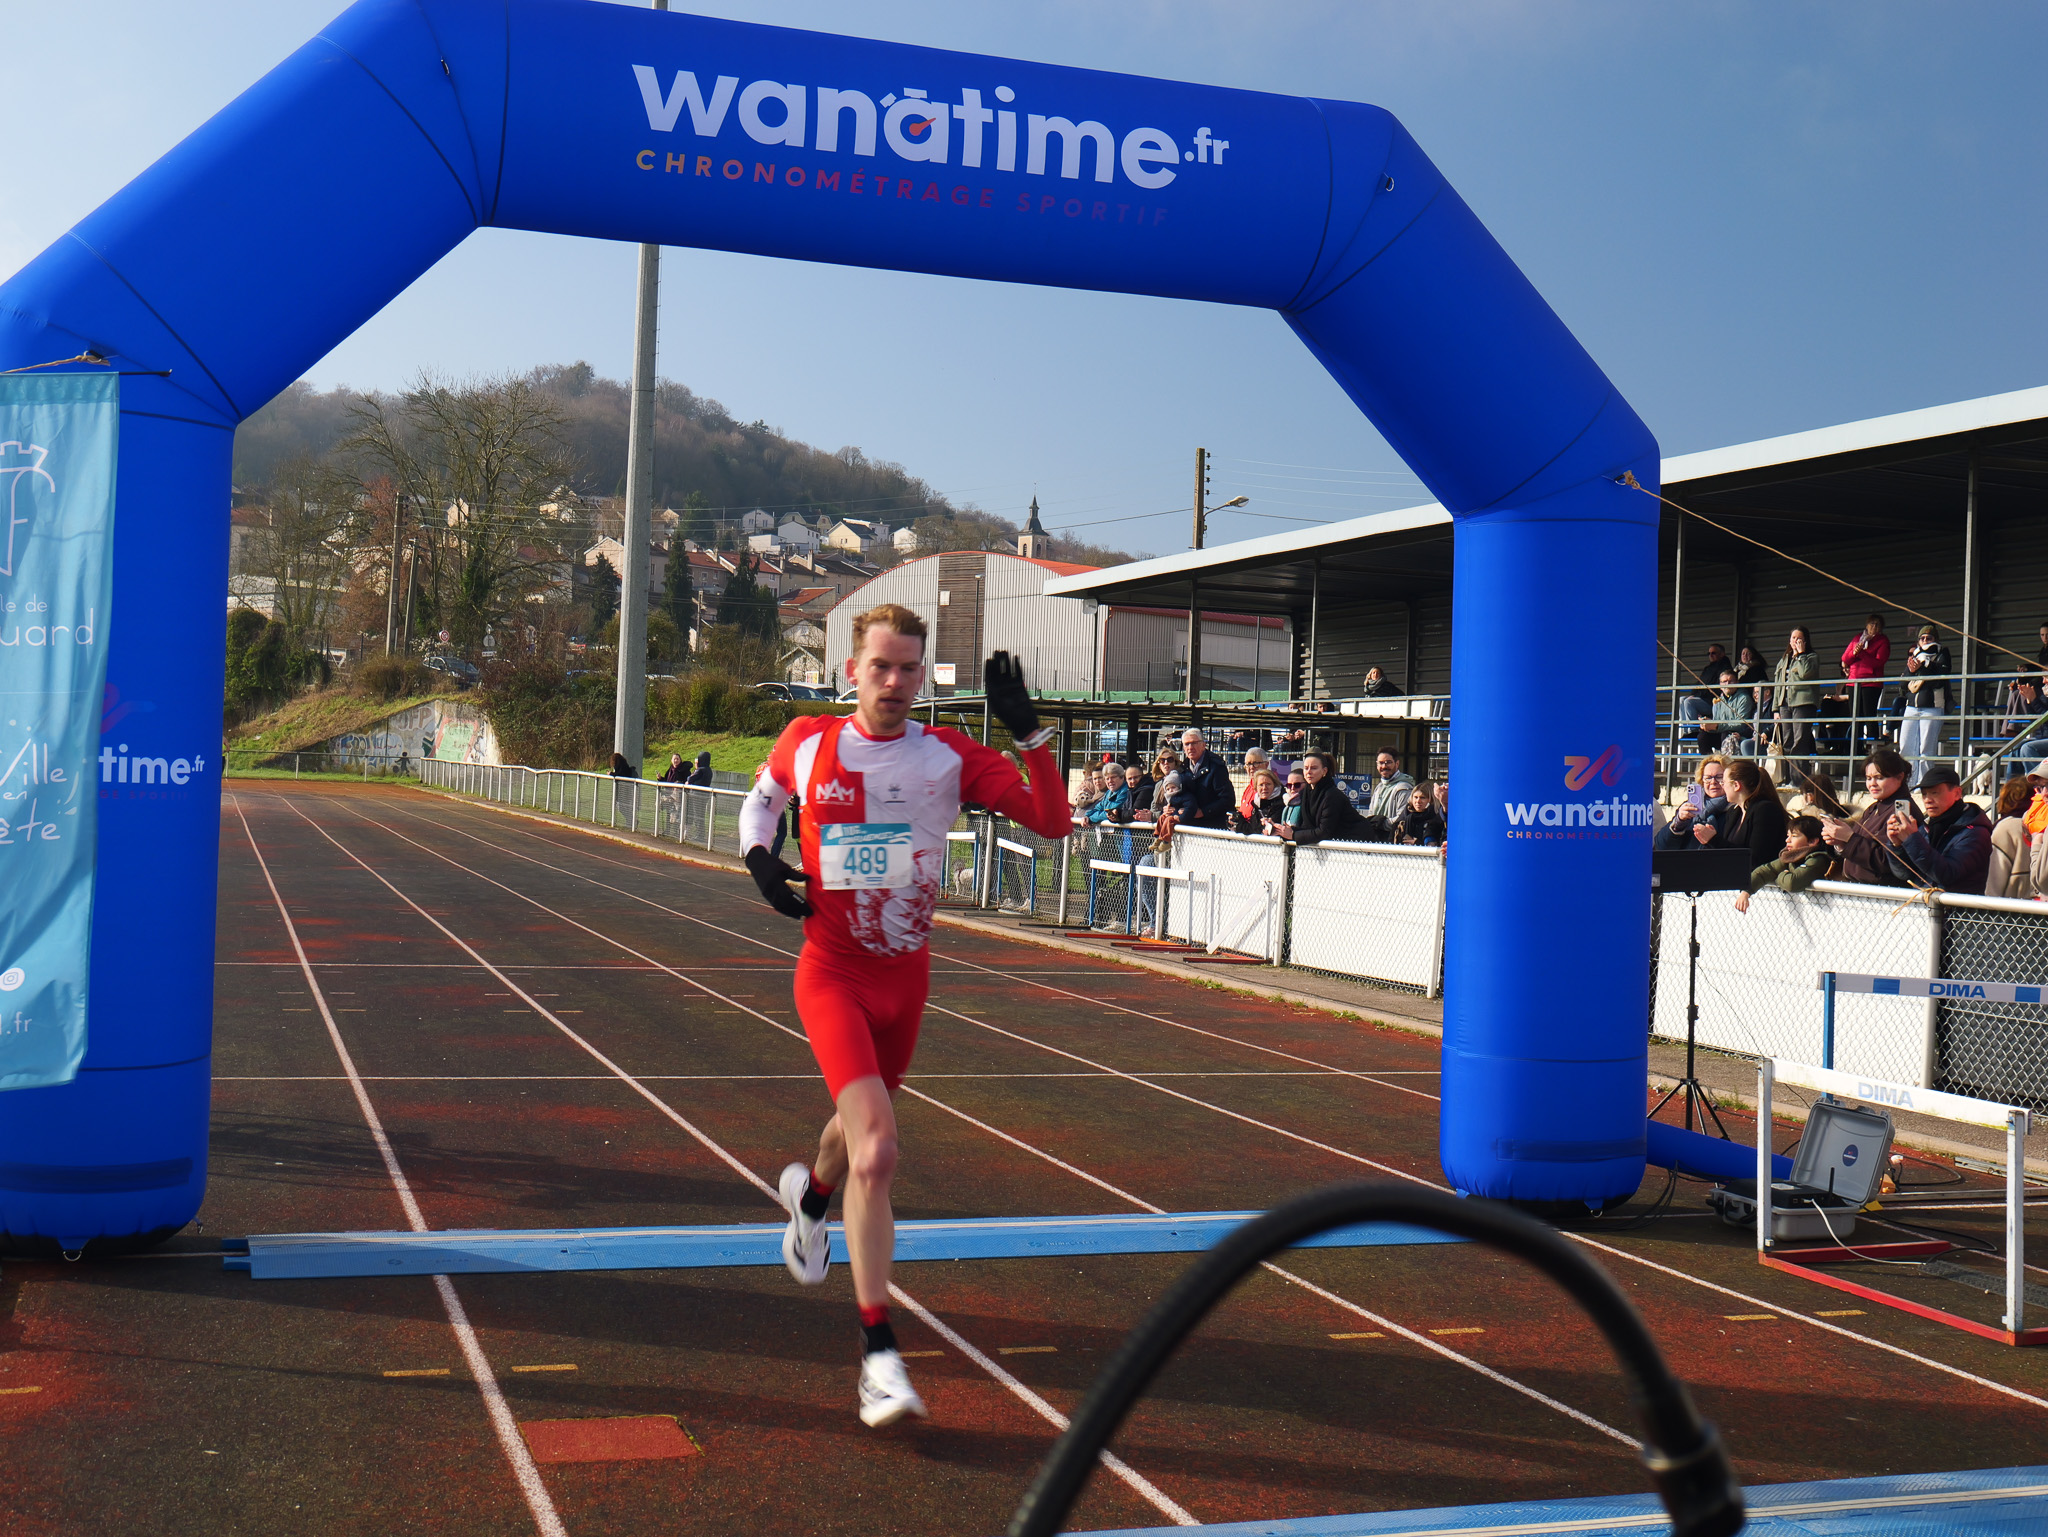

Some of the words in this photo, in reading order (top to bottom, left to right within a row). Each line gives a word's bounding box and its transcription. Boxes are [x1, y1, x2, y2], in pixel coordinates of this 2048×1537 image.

[635, 149, 995, 209] CHRONOMÉTRAGE
[1015, 192, 1169, 228] SPORTIF
[25, 593, 48, 613] de
[815, 778, 856, 803] NAM
[843, 846, 888, 875] 489
[1928, 982, 1987, 999] DIMA
[1857, 1081, 1915, 1109] DIMA
